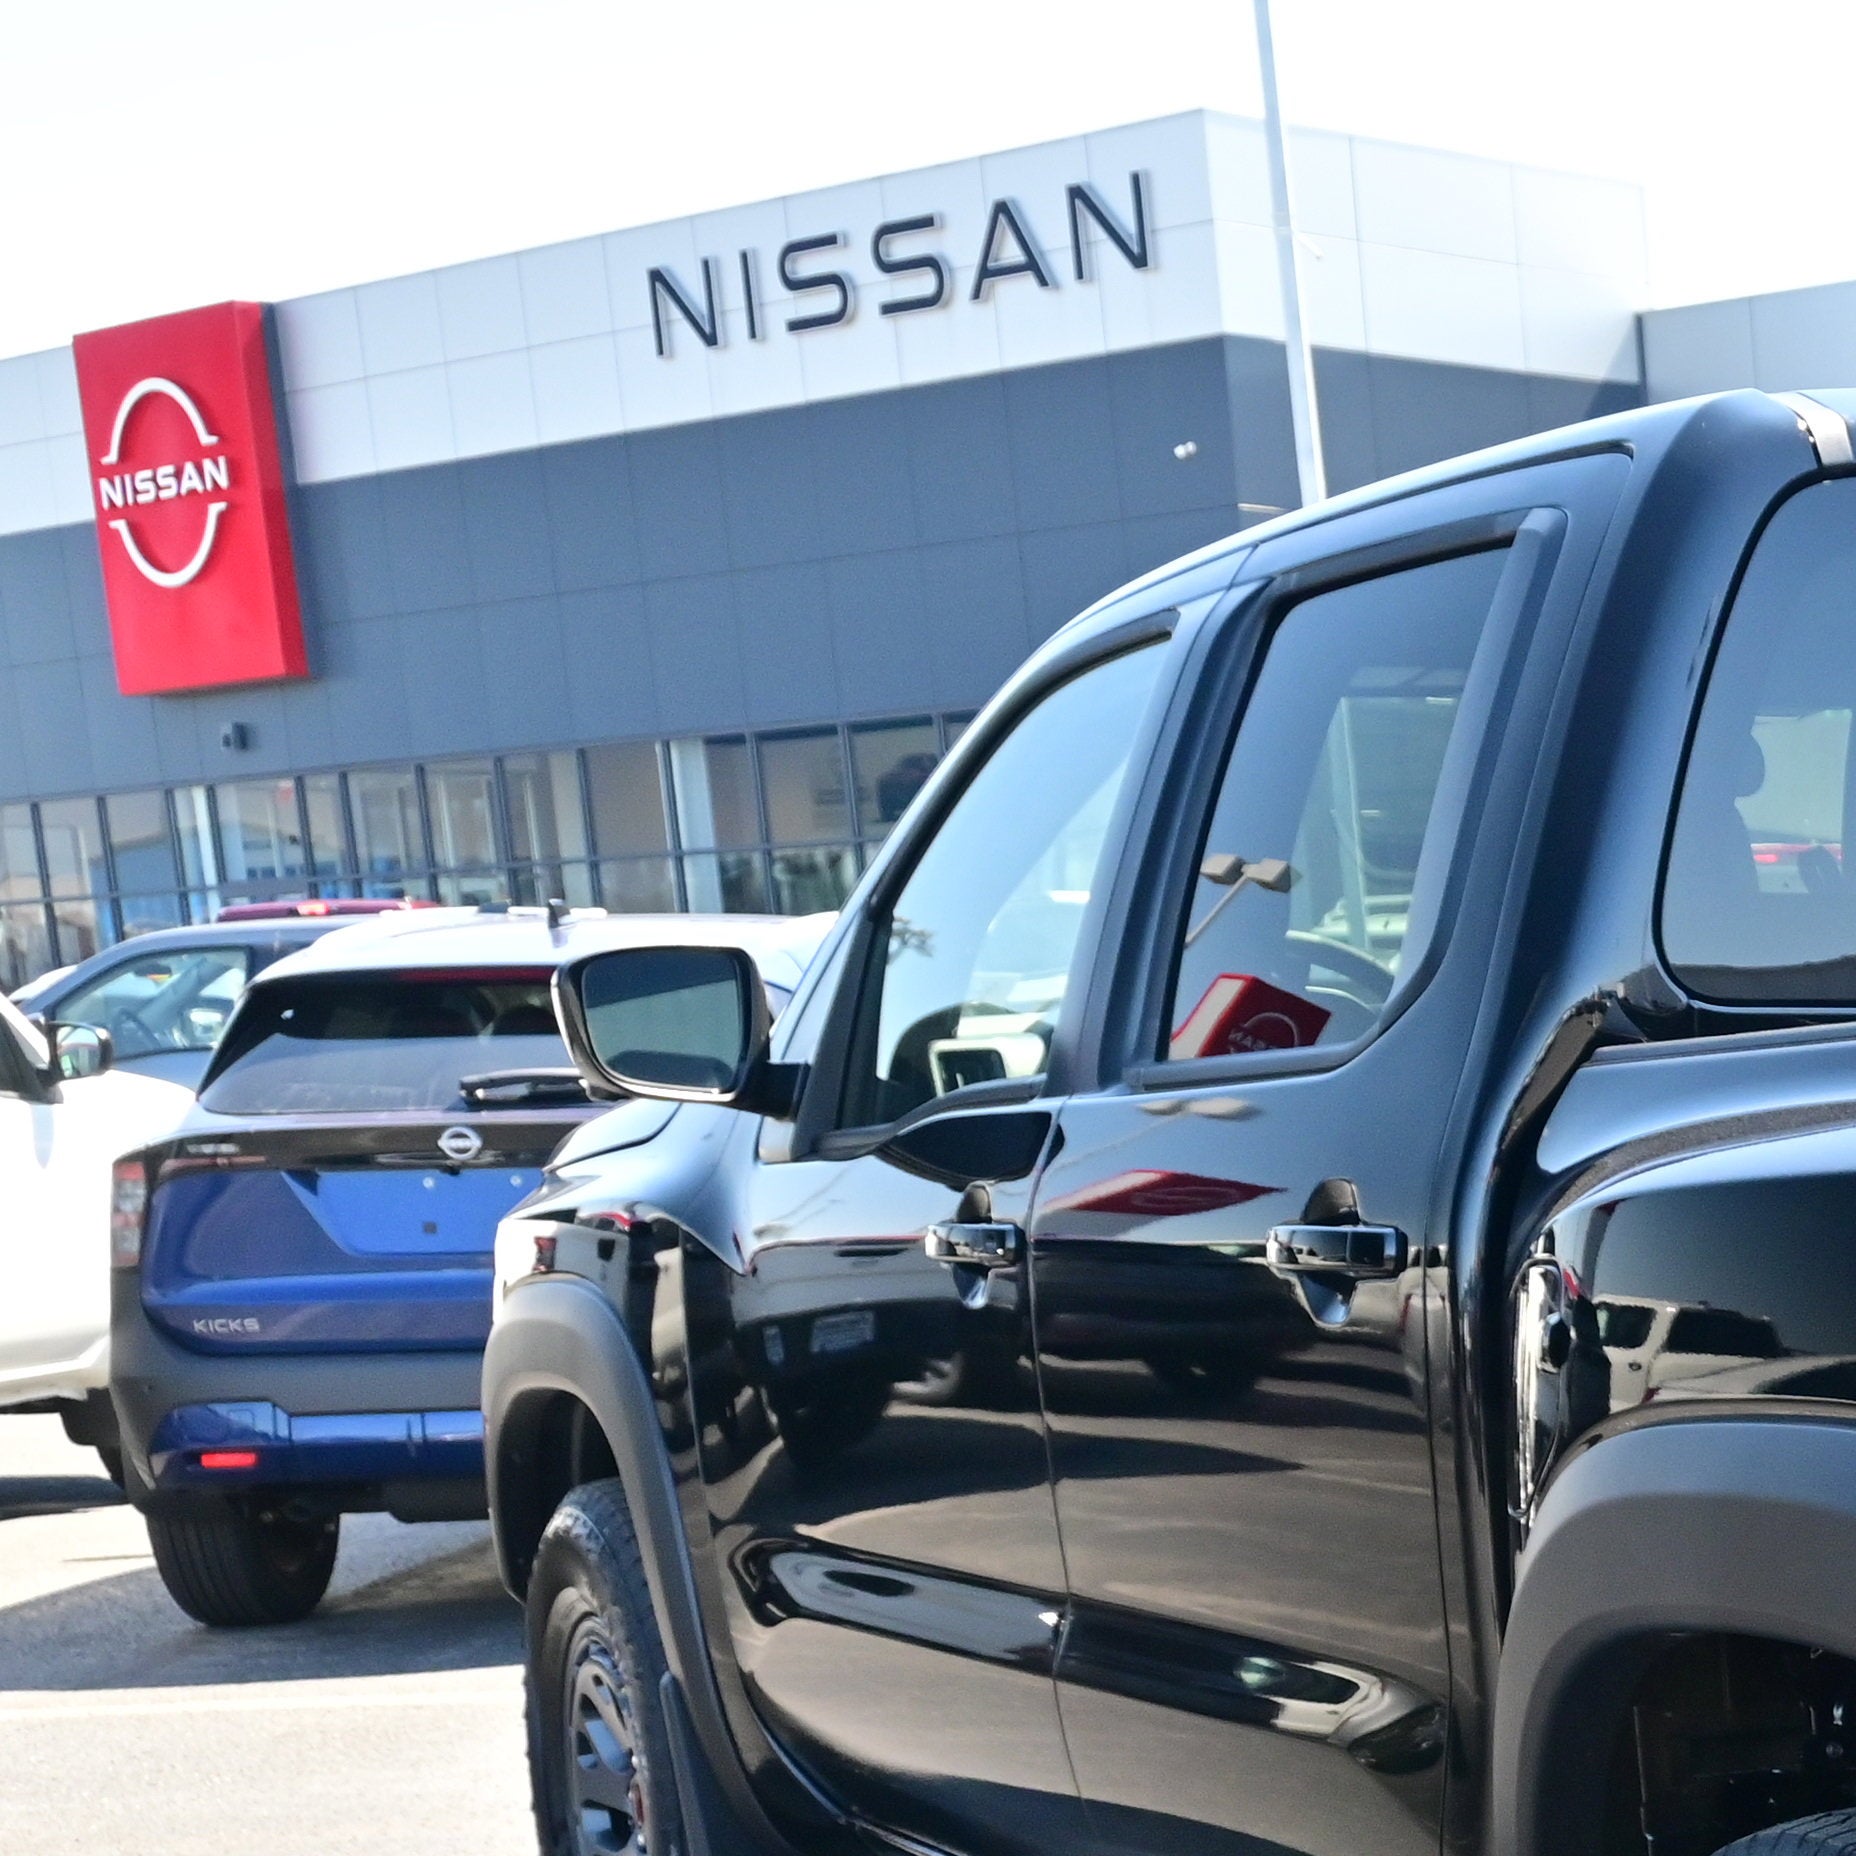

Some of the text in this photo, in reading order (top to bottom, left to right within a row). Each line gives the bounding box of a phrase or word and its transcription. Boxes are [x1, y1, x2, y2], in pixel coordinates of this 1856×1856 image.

[646, 168, 1152, 358] NISSAN
[99, 455, 231, 510] NISSAN
[192, 1316, 261, 1334] KICKS
